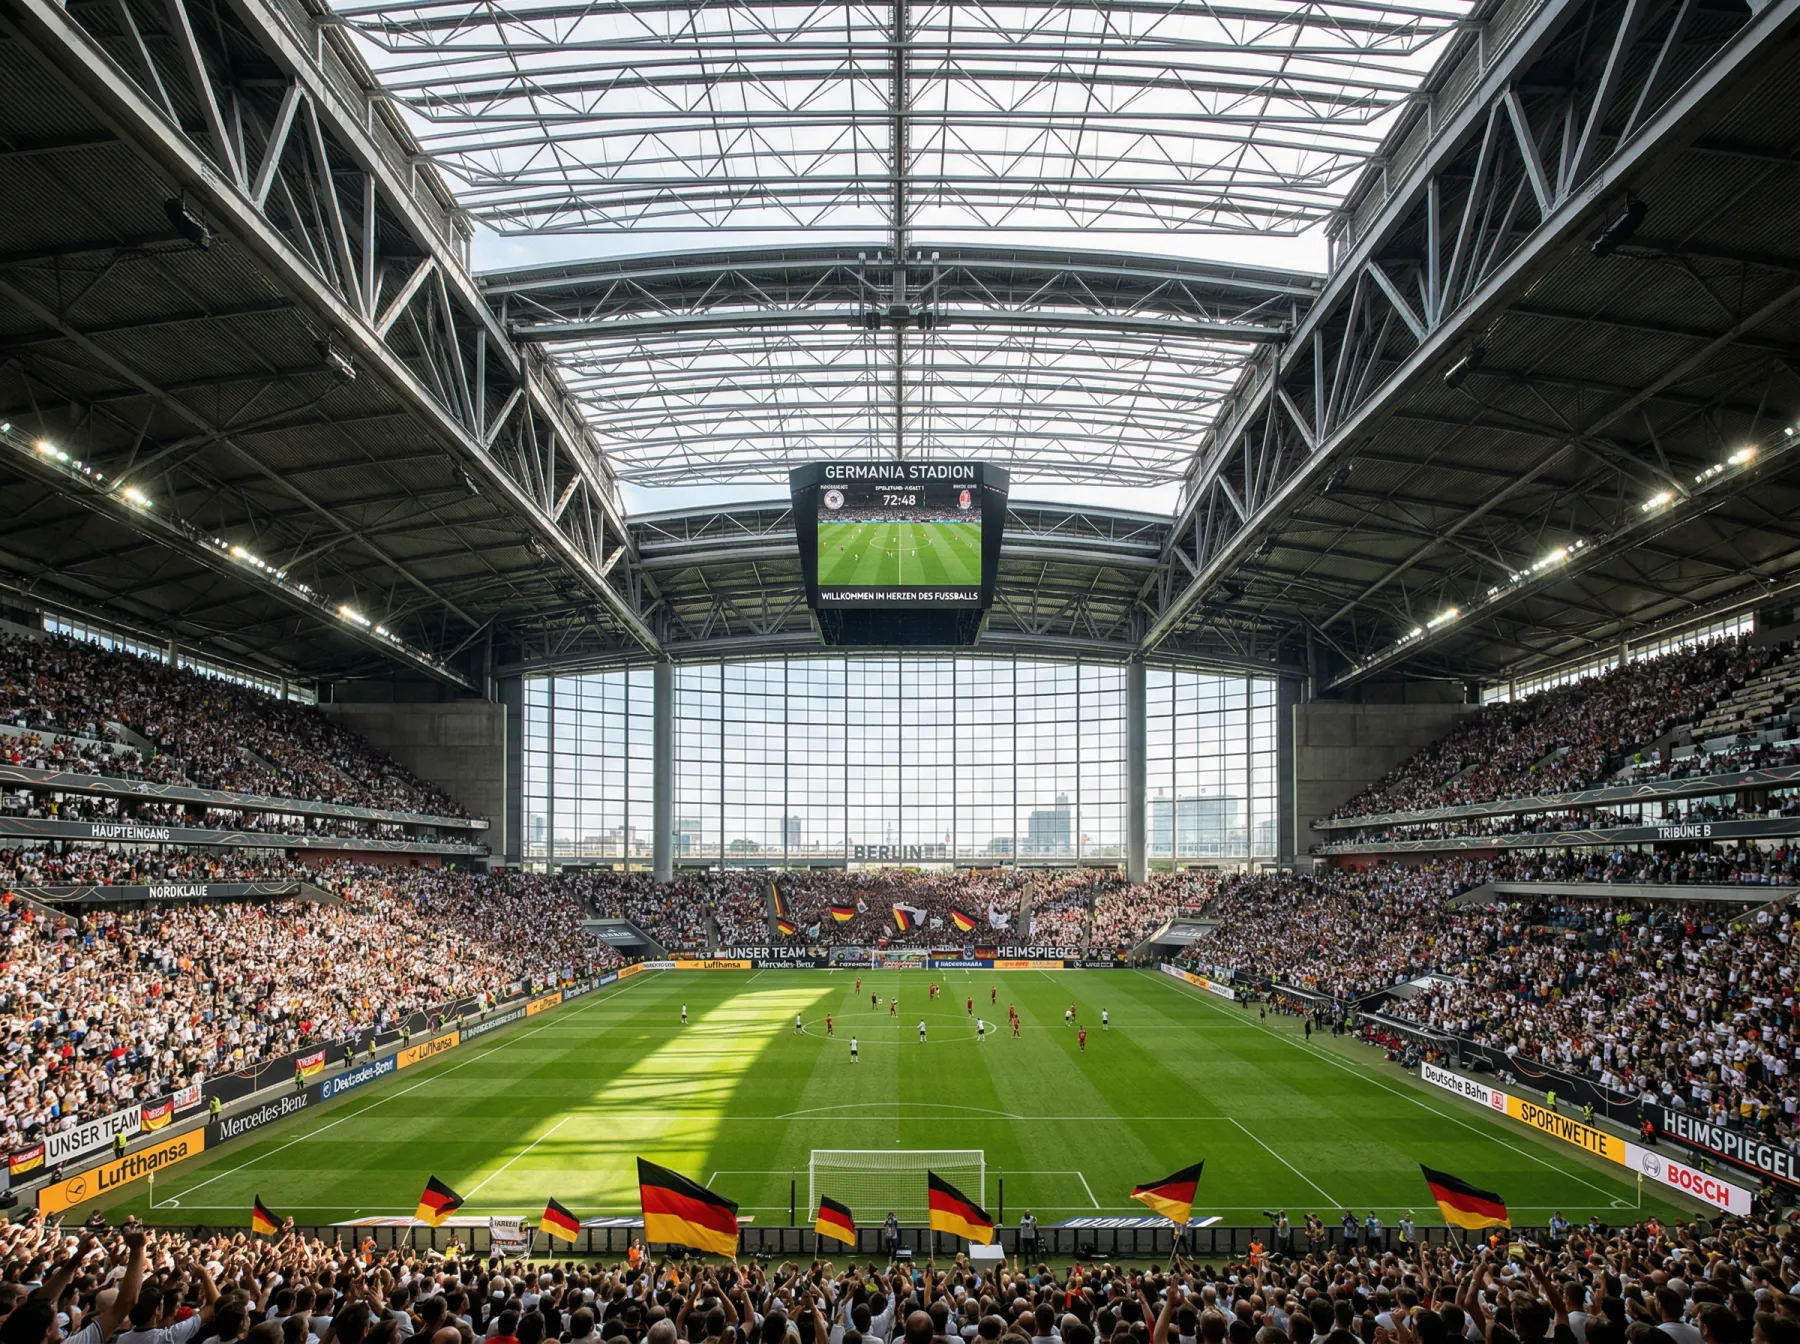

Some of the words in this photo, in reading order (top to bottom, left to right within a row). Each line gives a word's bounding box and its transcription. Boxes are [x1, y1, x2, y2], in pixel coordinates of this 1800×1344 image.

[825, 465, 905, 479] GERMANIA
[909, 465, 974, 479] STADION
[883, 494, 916, 506] 72:48
[821, 592, 874, 601] WILLKOMMEN
[886, 592, 917, 601] HERZEN
[918, 592, 933, 601] DES
[935, 592, 978, 601] FUSSBALLS
[91, 824, 170, 840] HAUPTEINGANG
[1703, 824, 1712, 837] B
[854, 845, 921, 860] BERLIN
[149, 885, 208, 898] NORDKLAUE
[728, 947, 769, 959] UNSER
[772, 946, 806, 958] TEAM
[1425, 1065, 1463, 1092] Deutsche
[1464, 1081, 1488, 1102] Bahn
[219, 1093, 308, 1141] Mercedes-Benz
[49, 1125, 100, 1158] UNSER
[102, 1109, 139, 1138] TEAM
[1521, 1103, 1608, 1155] SPORTWETTE
[1663, 1109, 1800, 1183] HEIMSPIEGEL
[98, 1141, 188, 1190] Lufthansa
[1667, 1163, 1730, 1207] BOSCH
